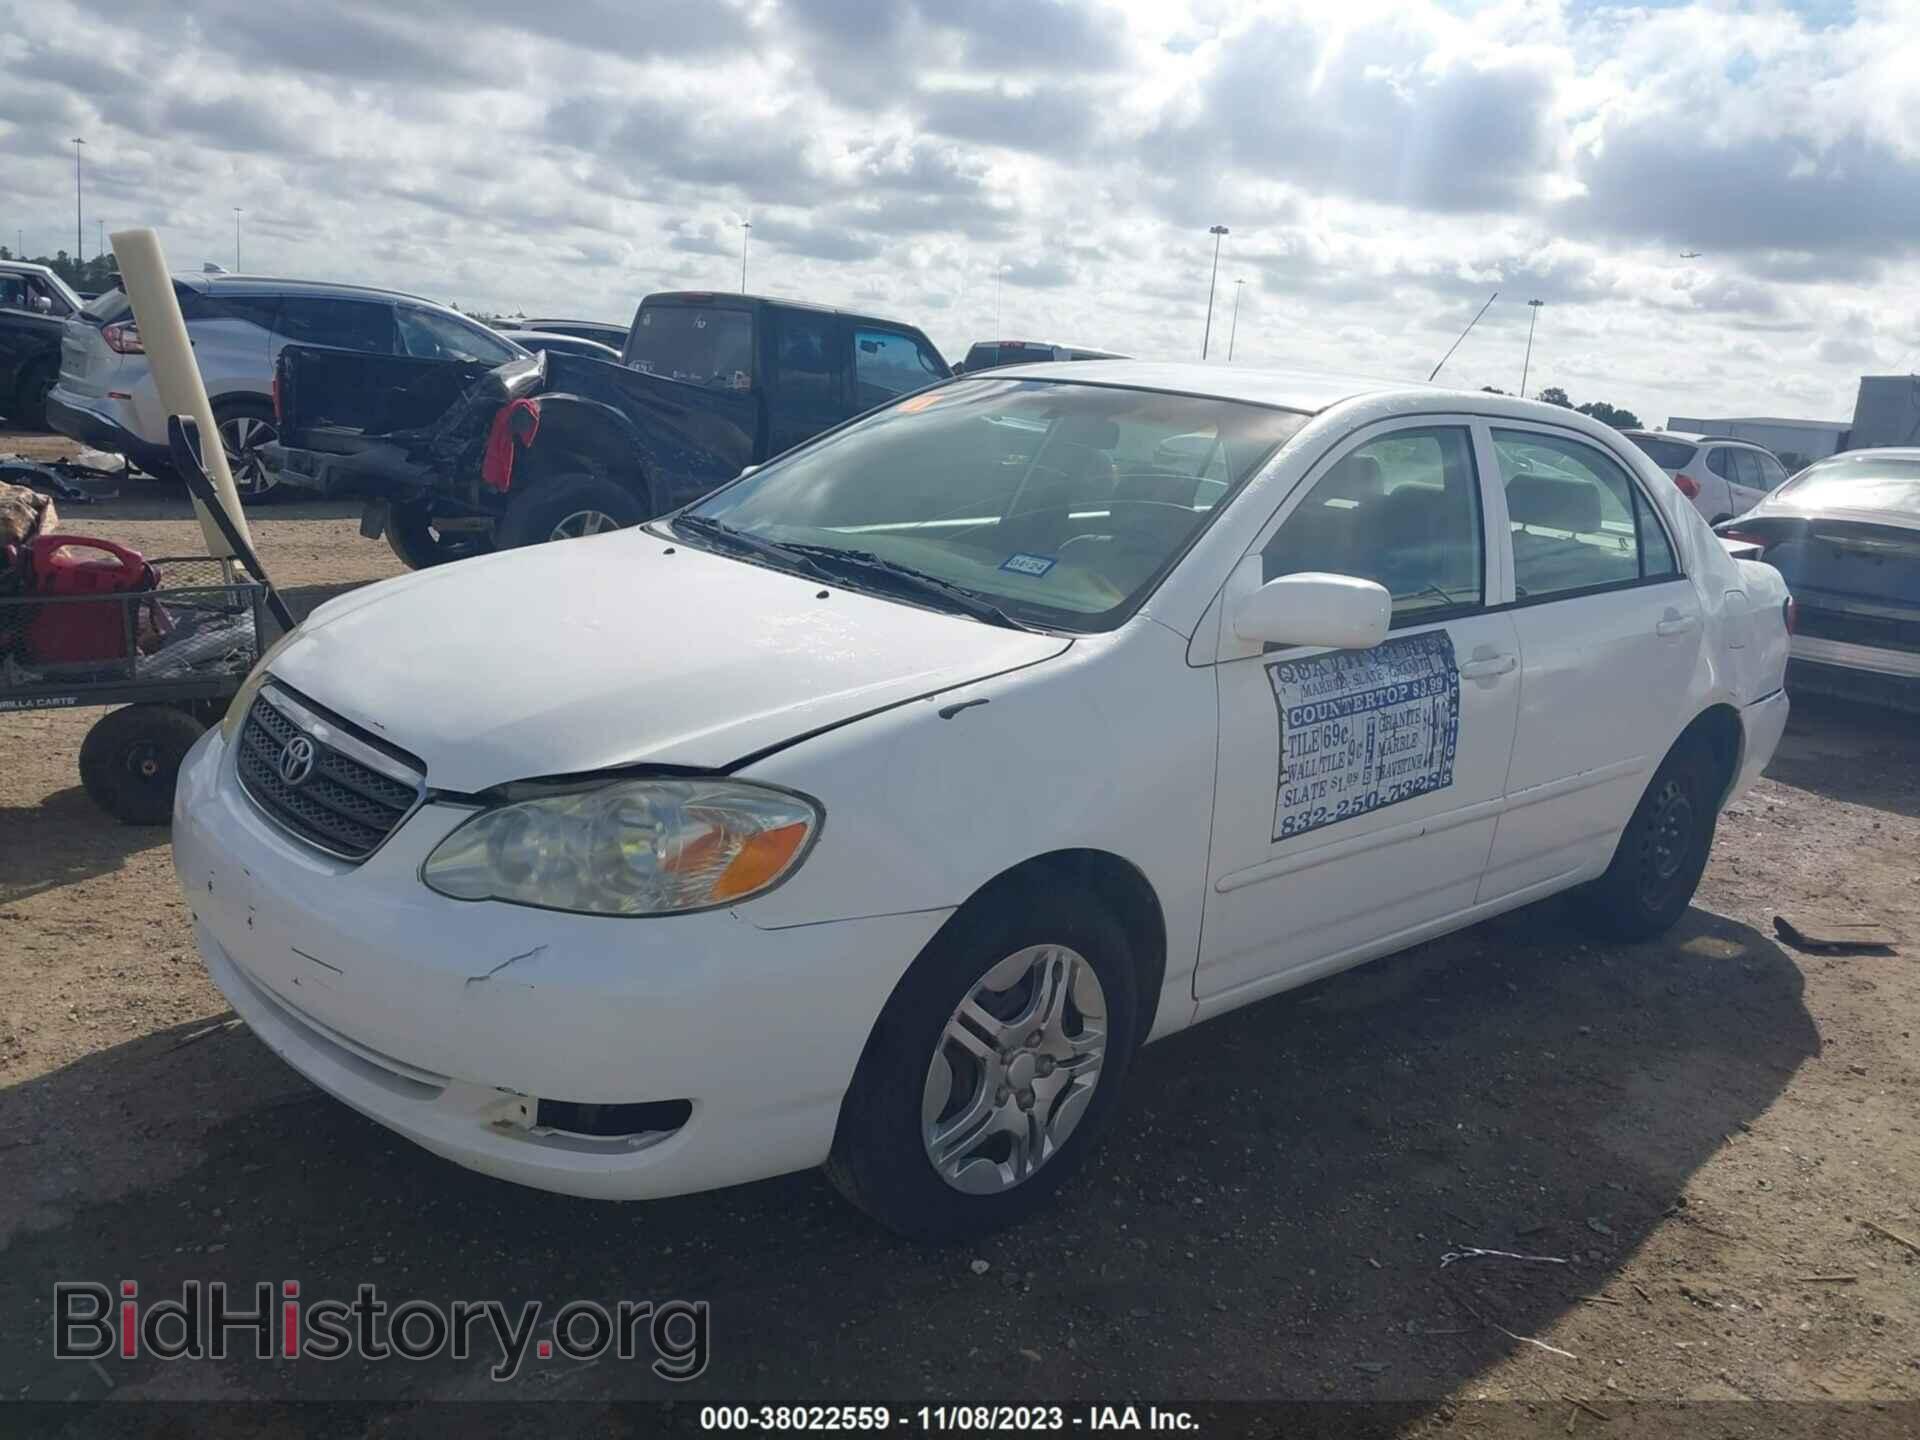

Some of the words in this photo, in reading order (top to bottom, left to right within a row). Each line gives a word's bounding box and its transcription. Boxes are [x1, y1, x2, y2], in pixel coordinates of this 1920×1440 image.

[1290, 685, 1408, 726] COUNTERTOP
[1288, 729, 1320, 759] TILE
[1287, 757, 1318, 783] WALL
[1319, 751, 1346, 775] TILE
[1283, 779, 1327, 809] SLATE
